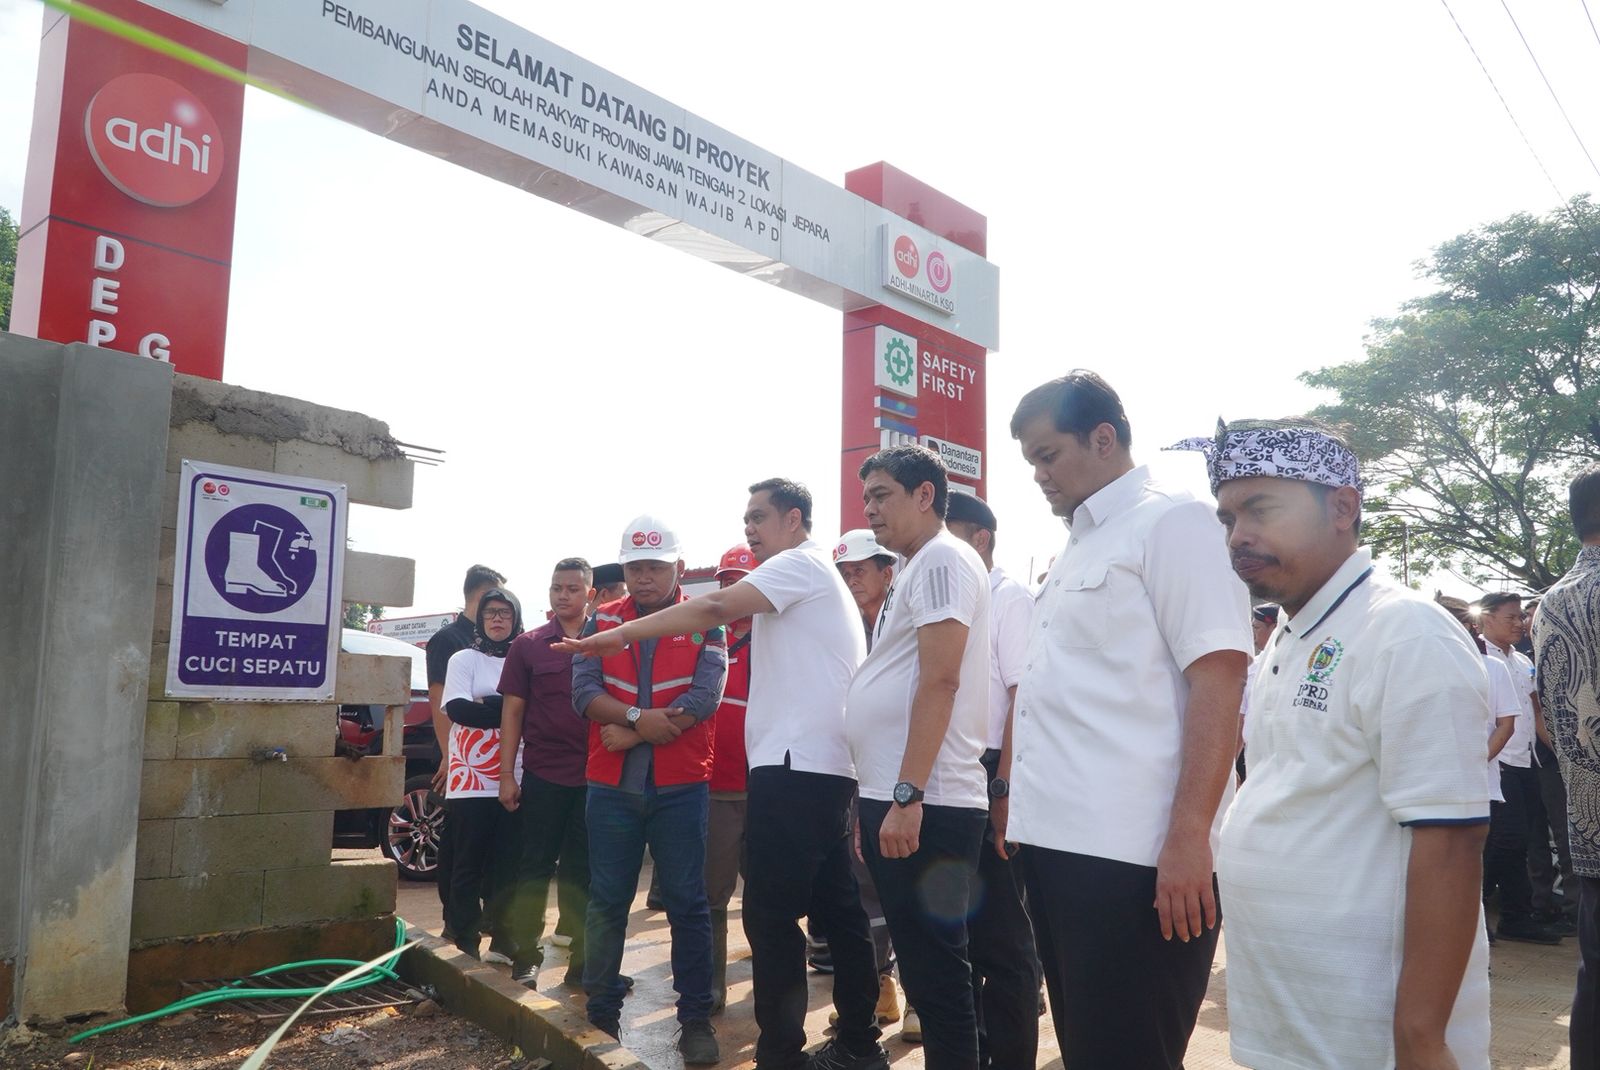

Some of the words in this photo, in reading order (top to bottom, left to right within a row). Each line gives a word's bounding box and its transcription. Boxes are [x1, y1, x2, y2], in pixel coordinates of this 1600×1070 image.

[322, 0, 459, 77] PEMBANGUNAN
[463, 65, 532, 109] SEKOLAH
[536, 97, 590, 134] RAKYAT
[592, 122, 650, 163] PROVINSI
[653, 152, 685, 178] JAWA
[687, 165, 735, 200] TENGAH
[738, 189, 746, 205] 2
[750, 194, 787, 223] LOKASI
[792, 215, 830, 242] JEPARA
[457, 23, 574, 98] SELAMAT
[581, 82, 667, 142] DATANG
[672, 126, 692, 155] DI
[696, 137, 770, 192] PROYEK
[105, 117, 212, 174] adhi
[426, 78, 482, 116] ANDA
[493, 105, 590, 162] MEMASUKI
[598, 151, 678, 199] KAWASAN
[685, 189, 734, 222] WAJIB
[896, 249, 918, 269] adhi
[890, 274, 940, 306] ADHI-MINARTA
[940, 297, 955, 312] KSO
[922, 351, 976, 384] SAFETY
[922, 372, 964, 401] FIRST
[941, 443, 979, 463] Danantara
[215, 630, 297, 650] TEMPAT
[185, 655, 236, 674] CUCI
[242, 656, 321, 676] SEPATU
